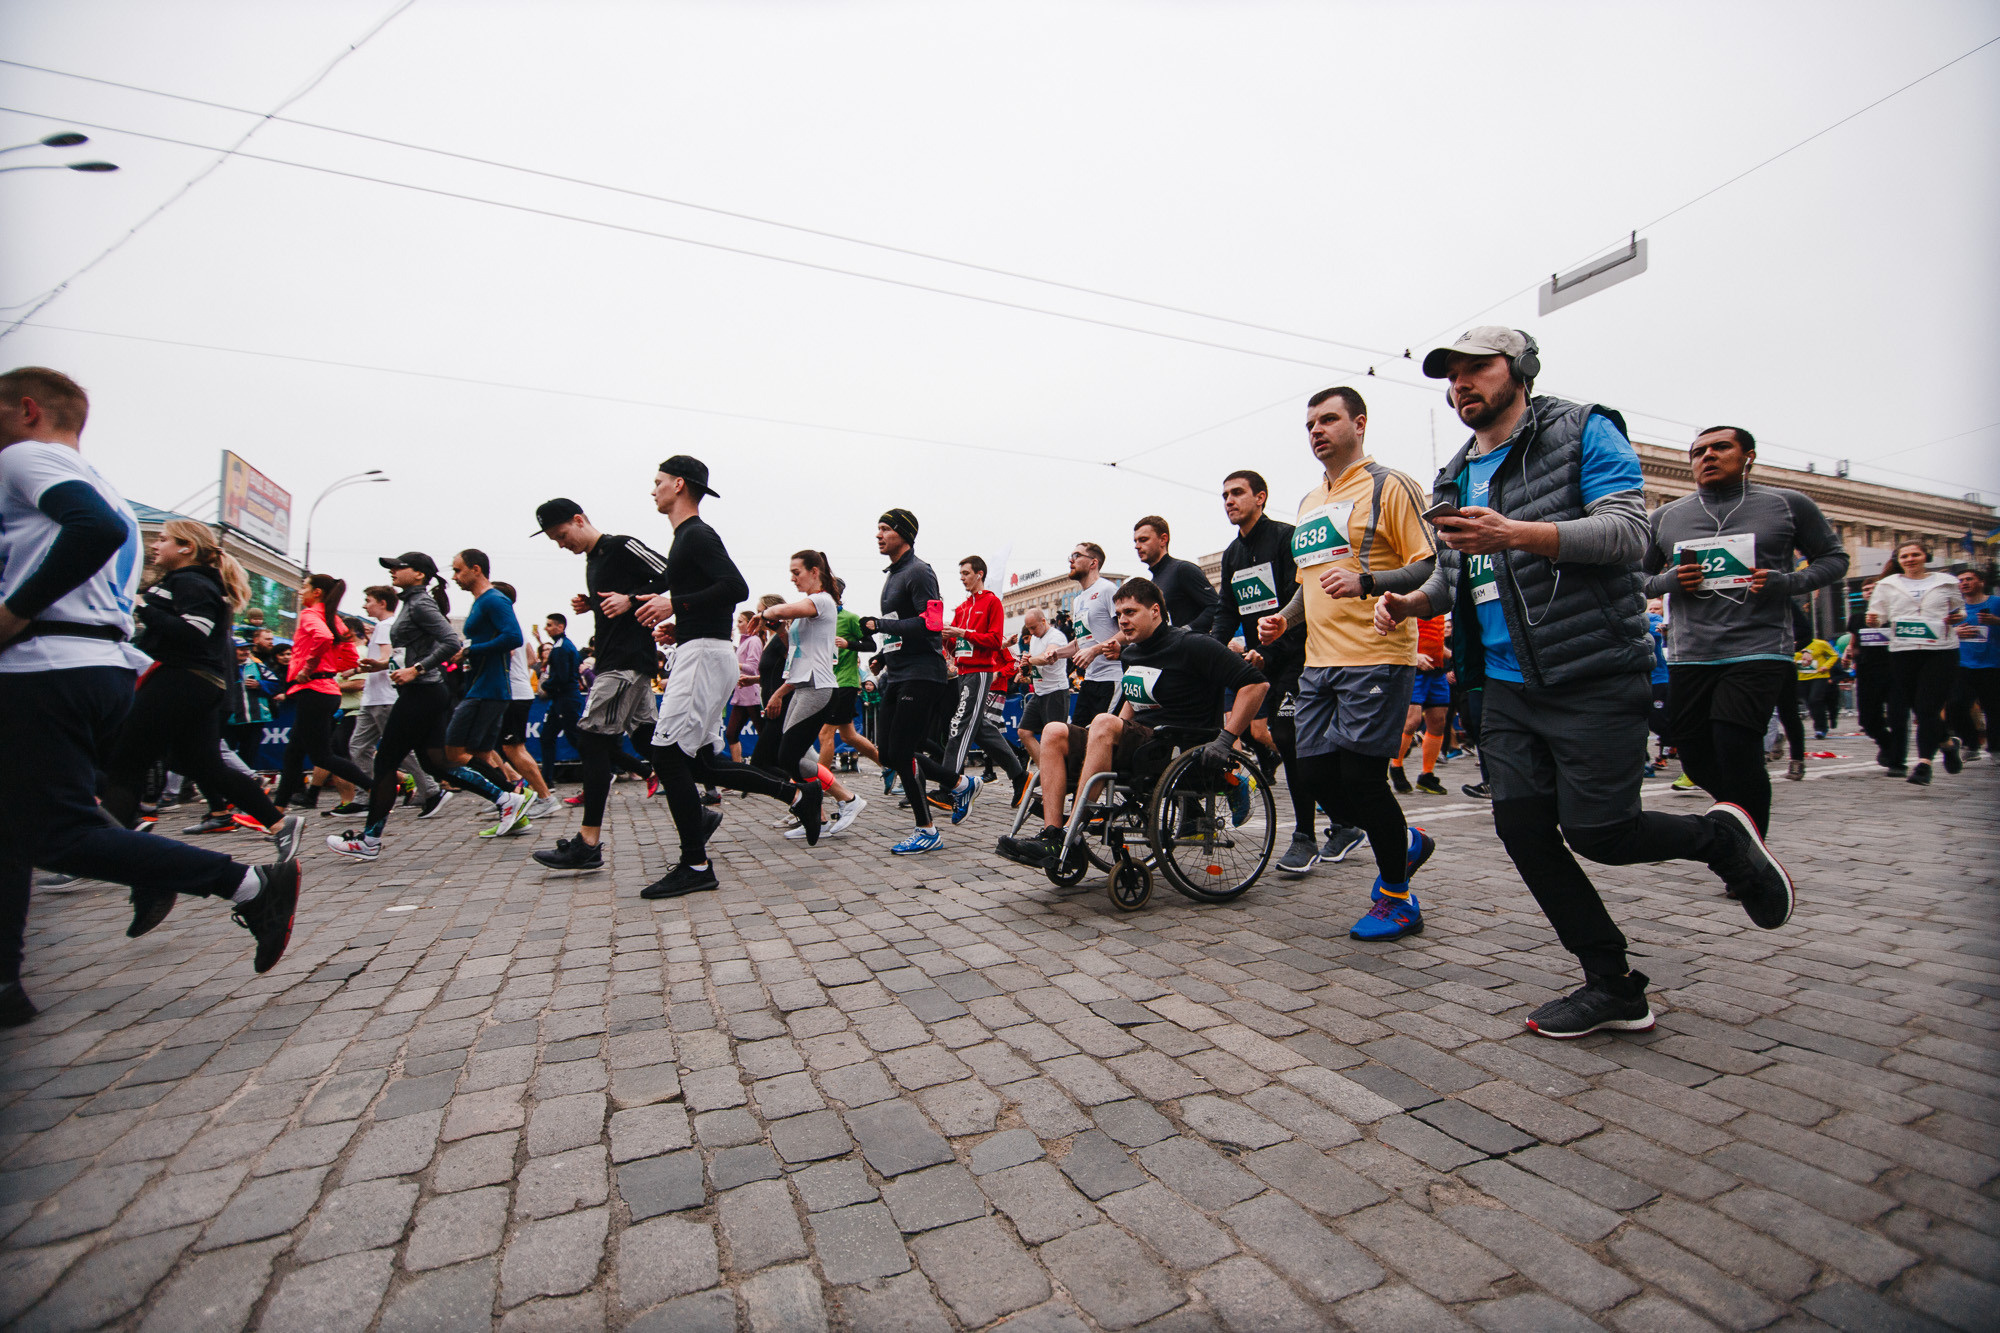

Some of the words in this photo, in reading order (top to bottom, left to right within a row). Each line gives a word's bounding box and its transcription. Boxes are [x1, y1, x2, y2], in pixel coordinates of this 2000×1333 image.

[1295, 526, 1327, 550] 1538
[1237, 584, 1261, 600] 1494
[1897, 626, 1926, 635] 2425
[1124, 683, 1142, 698] 2451
[950, 700, 967, 737] adidas
